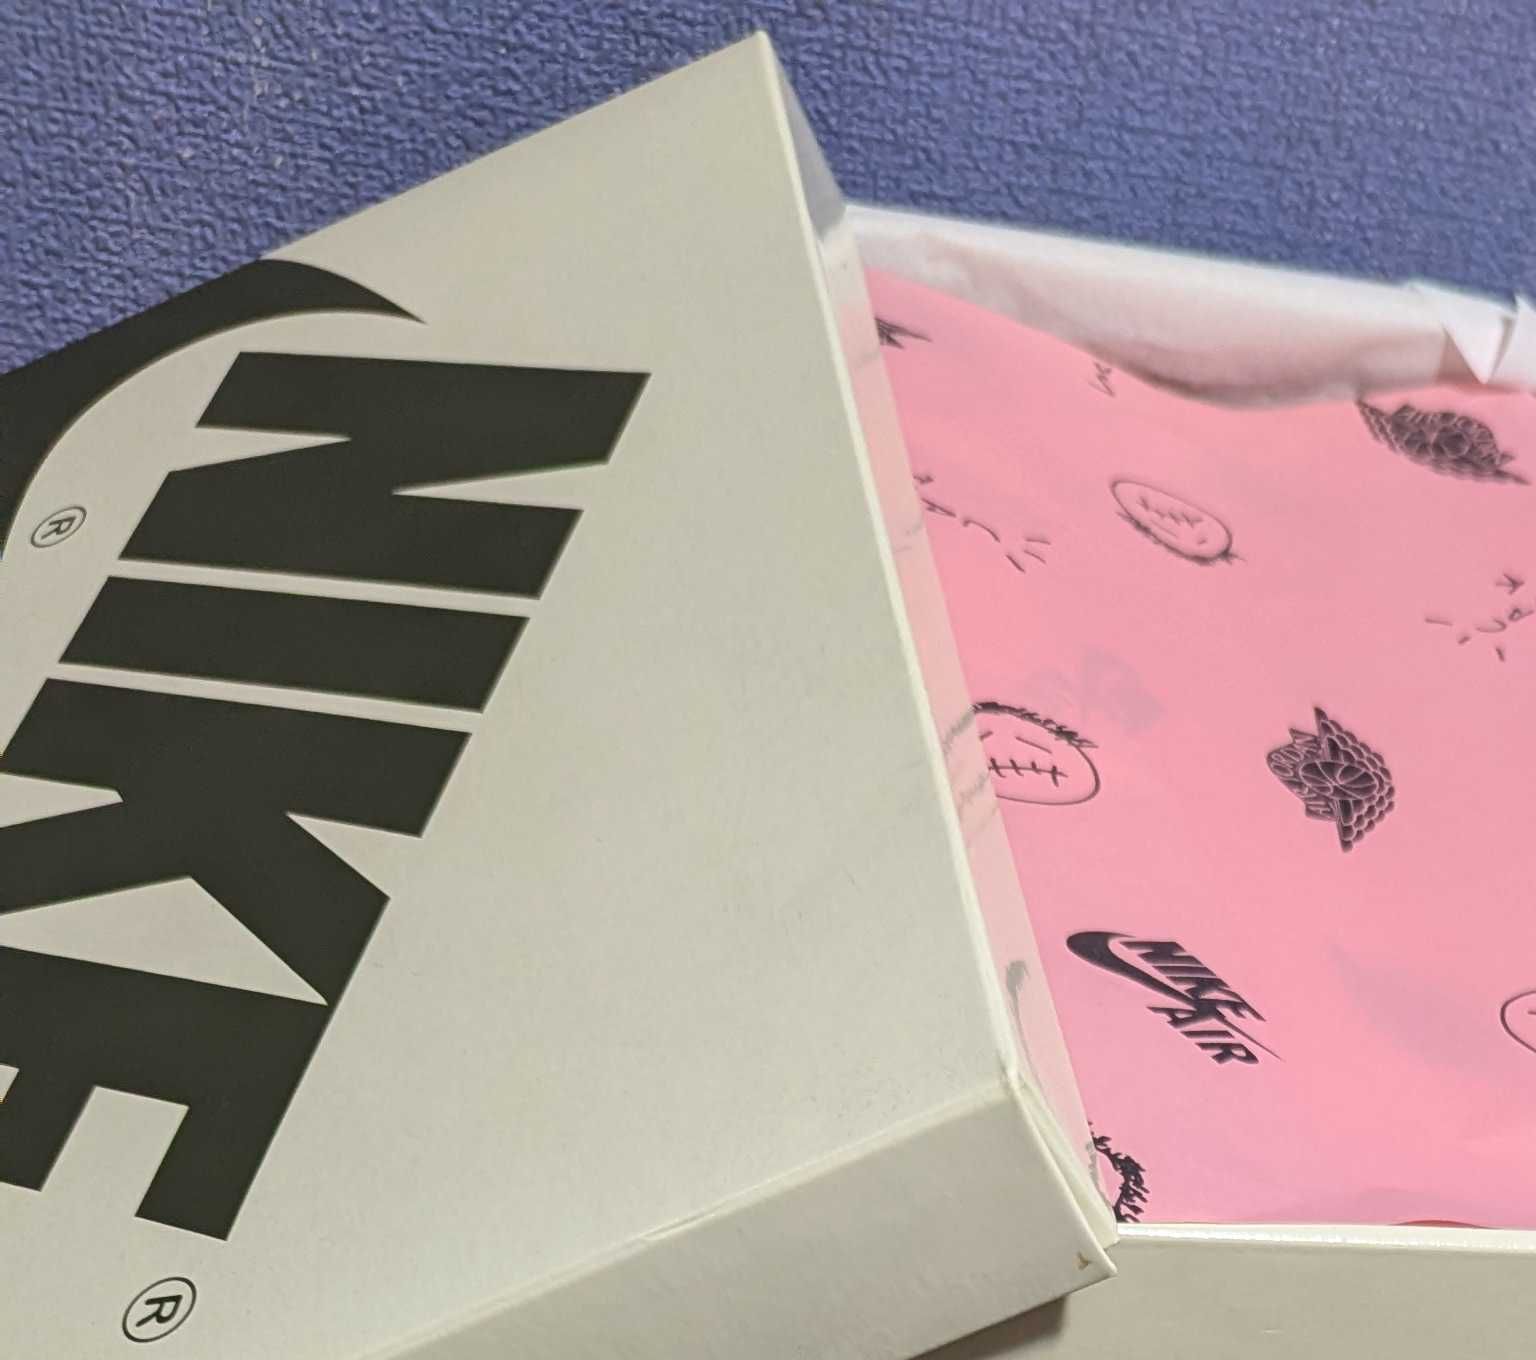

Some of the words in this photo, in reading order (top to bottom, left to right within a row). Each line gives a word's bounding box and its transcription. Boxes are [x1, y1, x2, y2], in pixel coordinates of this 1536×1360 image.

[0, 350, 652, 1242] NIKE
[1119, 940, 1267, 1022] NIKE
[1146, 1005, 1260, 1065] AIR
